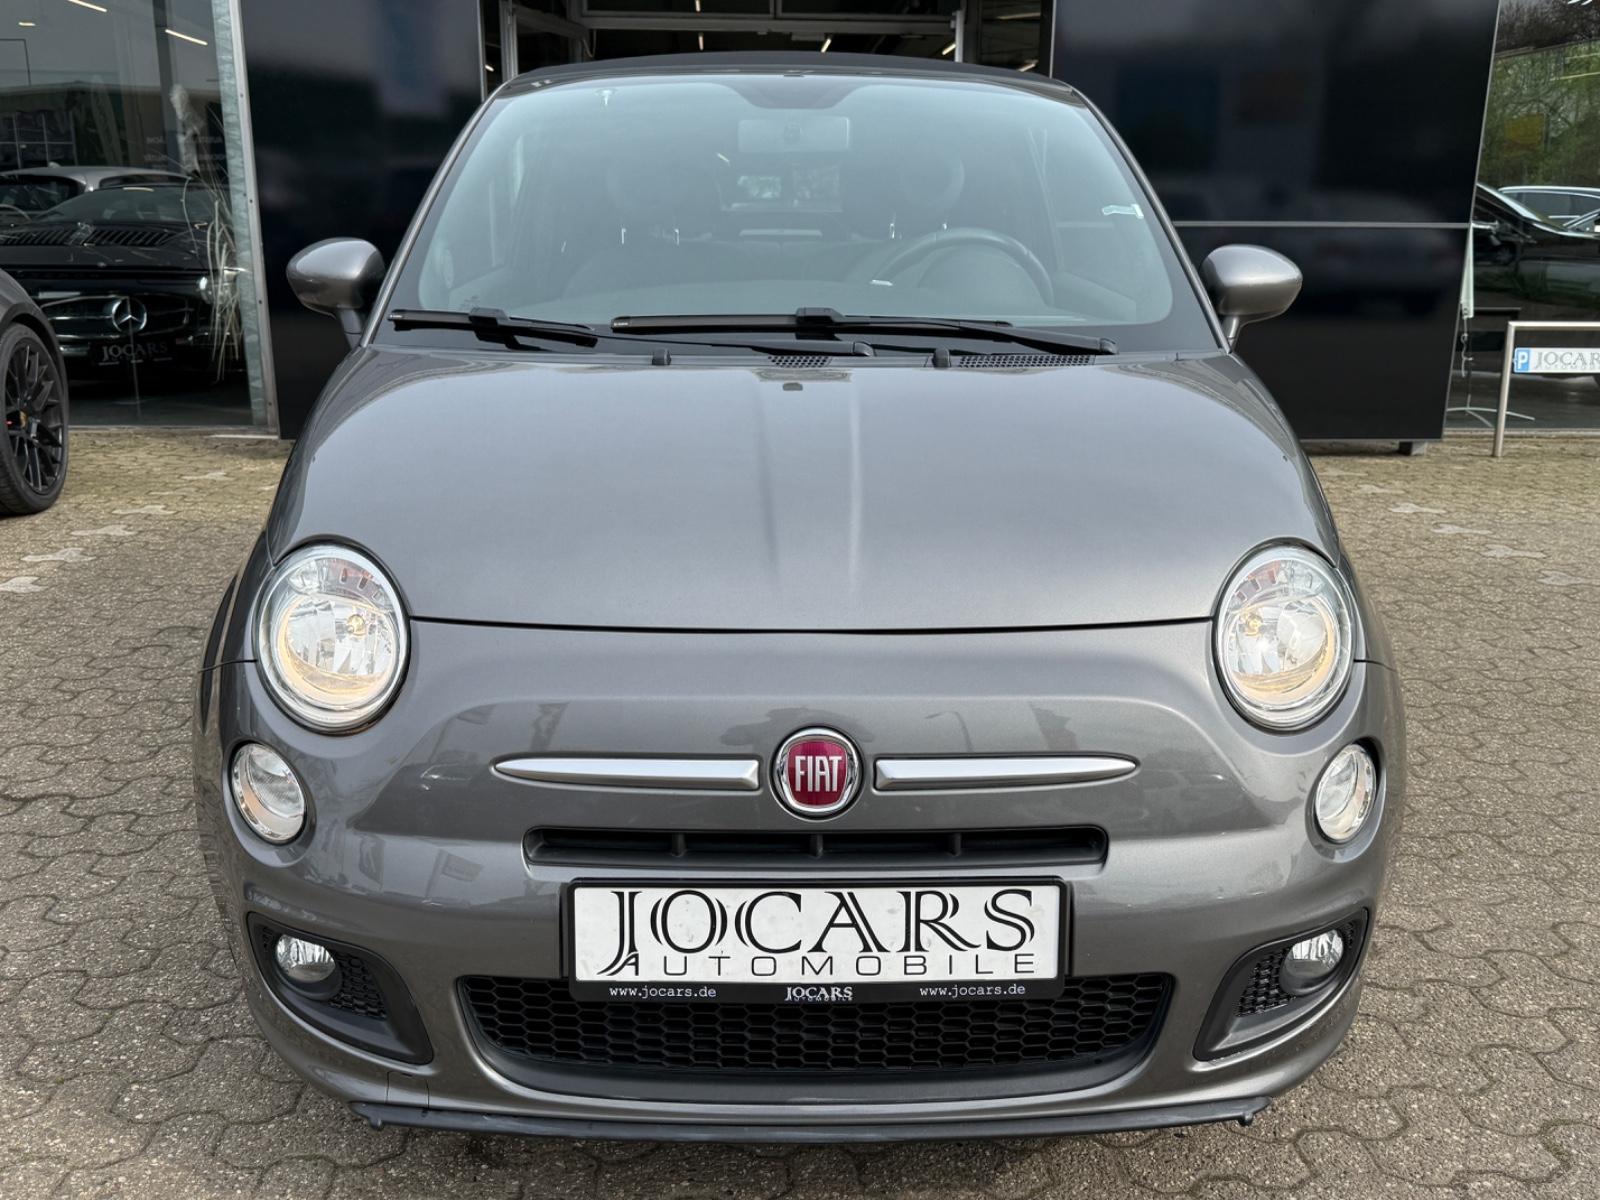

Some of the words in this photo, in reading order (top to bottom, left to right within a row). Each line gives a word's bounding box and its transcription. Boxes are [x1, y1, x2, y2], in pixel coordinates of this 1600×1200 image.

[1517, 351, 1529, 370] P
[794, 755, 843, 792] FIAT
[596, 889, 1036, 976] JOCARS
[620, 951, 1036, 977] AUTOMOBILE
[609, 985, 717, 999] www.jocars.de
[785, 986, 853, 1001] JOCARS
[919, 983, 1026, 999] www.jocars.de
